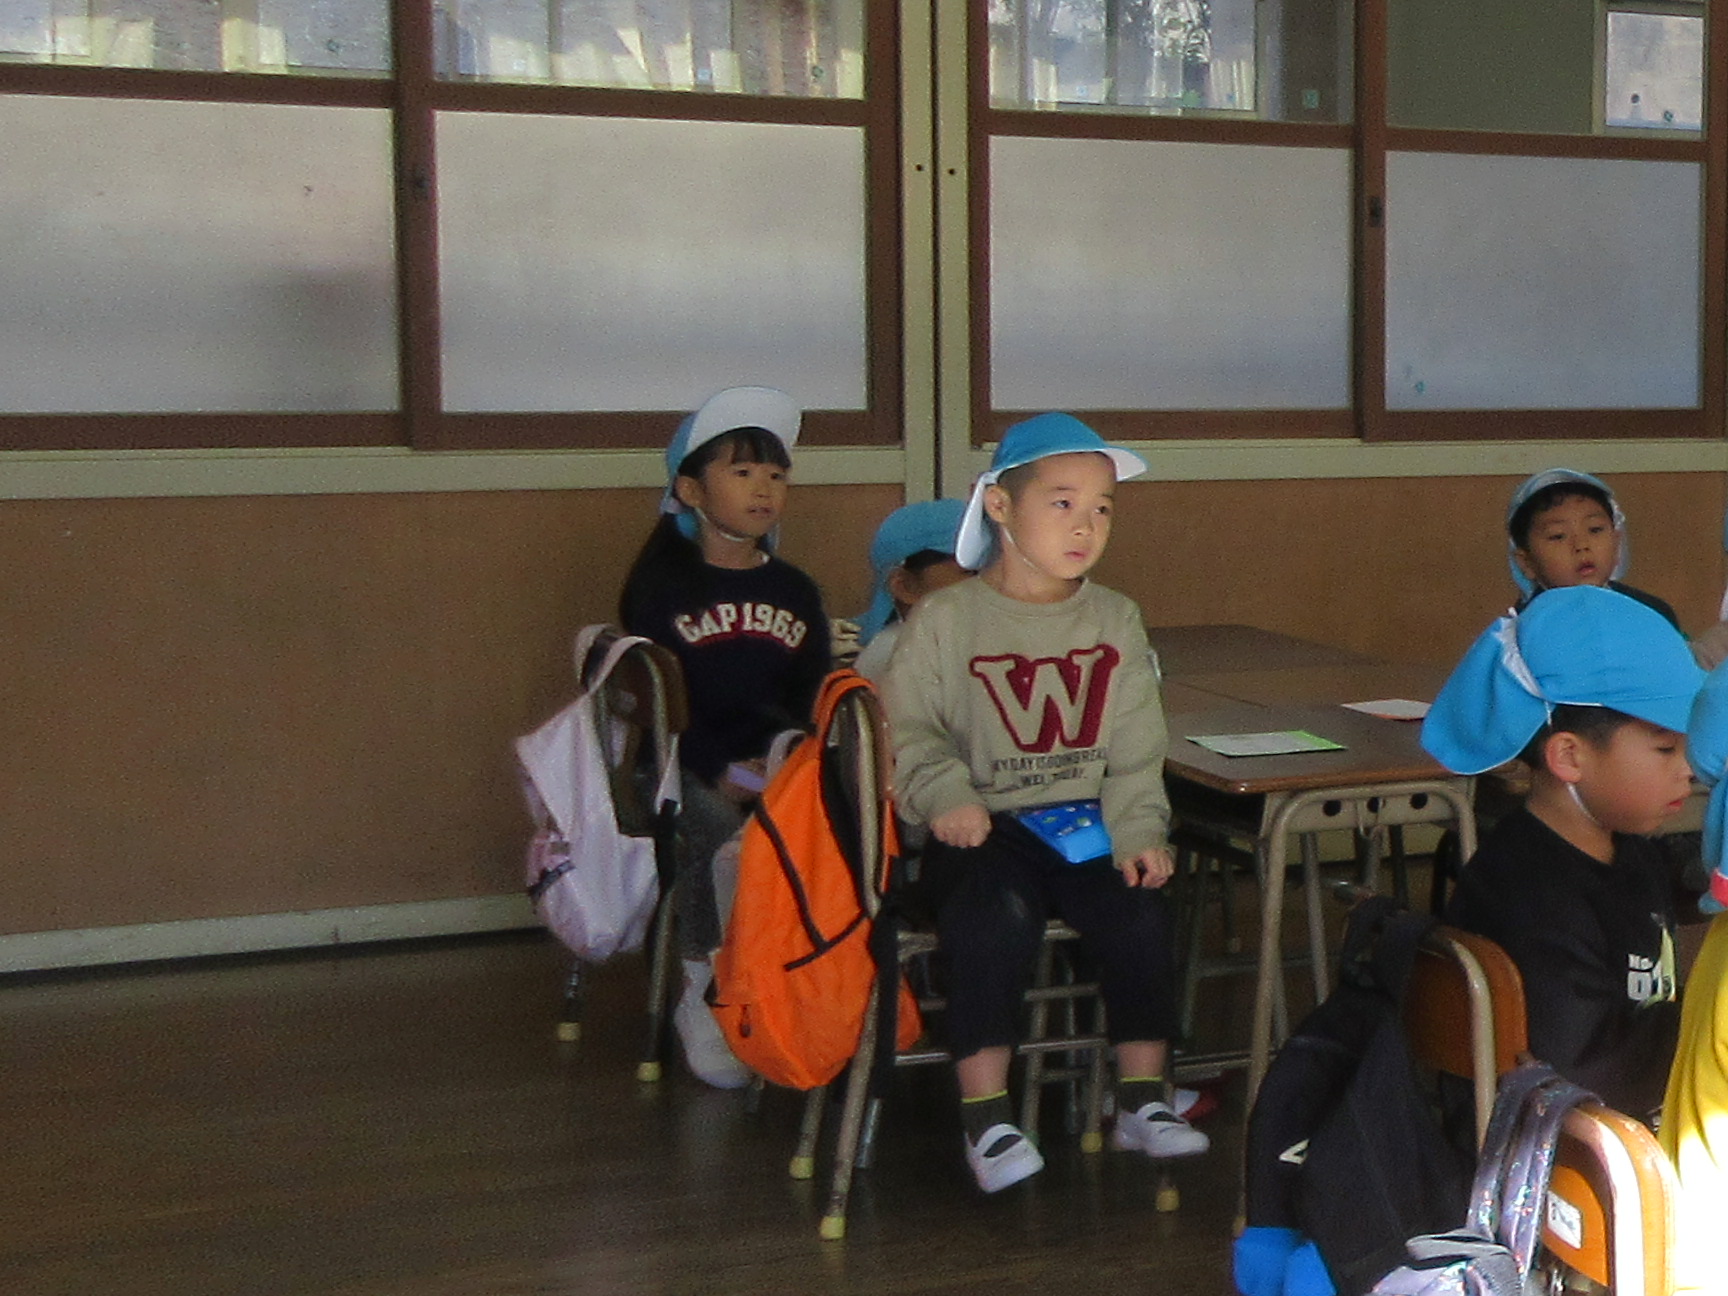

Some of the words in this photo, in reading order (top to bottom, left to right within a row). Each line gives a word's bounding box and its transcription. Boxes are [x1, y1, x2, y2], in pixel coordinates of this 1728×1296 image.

[673, 601, 739, 647] GAP
[741, 601, 808, 649] 1969
[969, 643, 1121, 754] W
